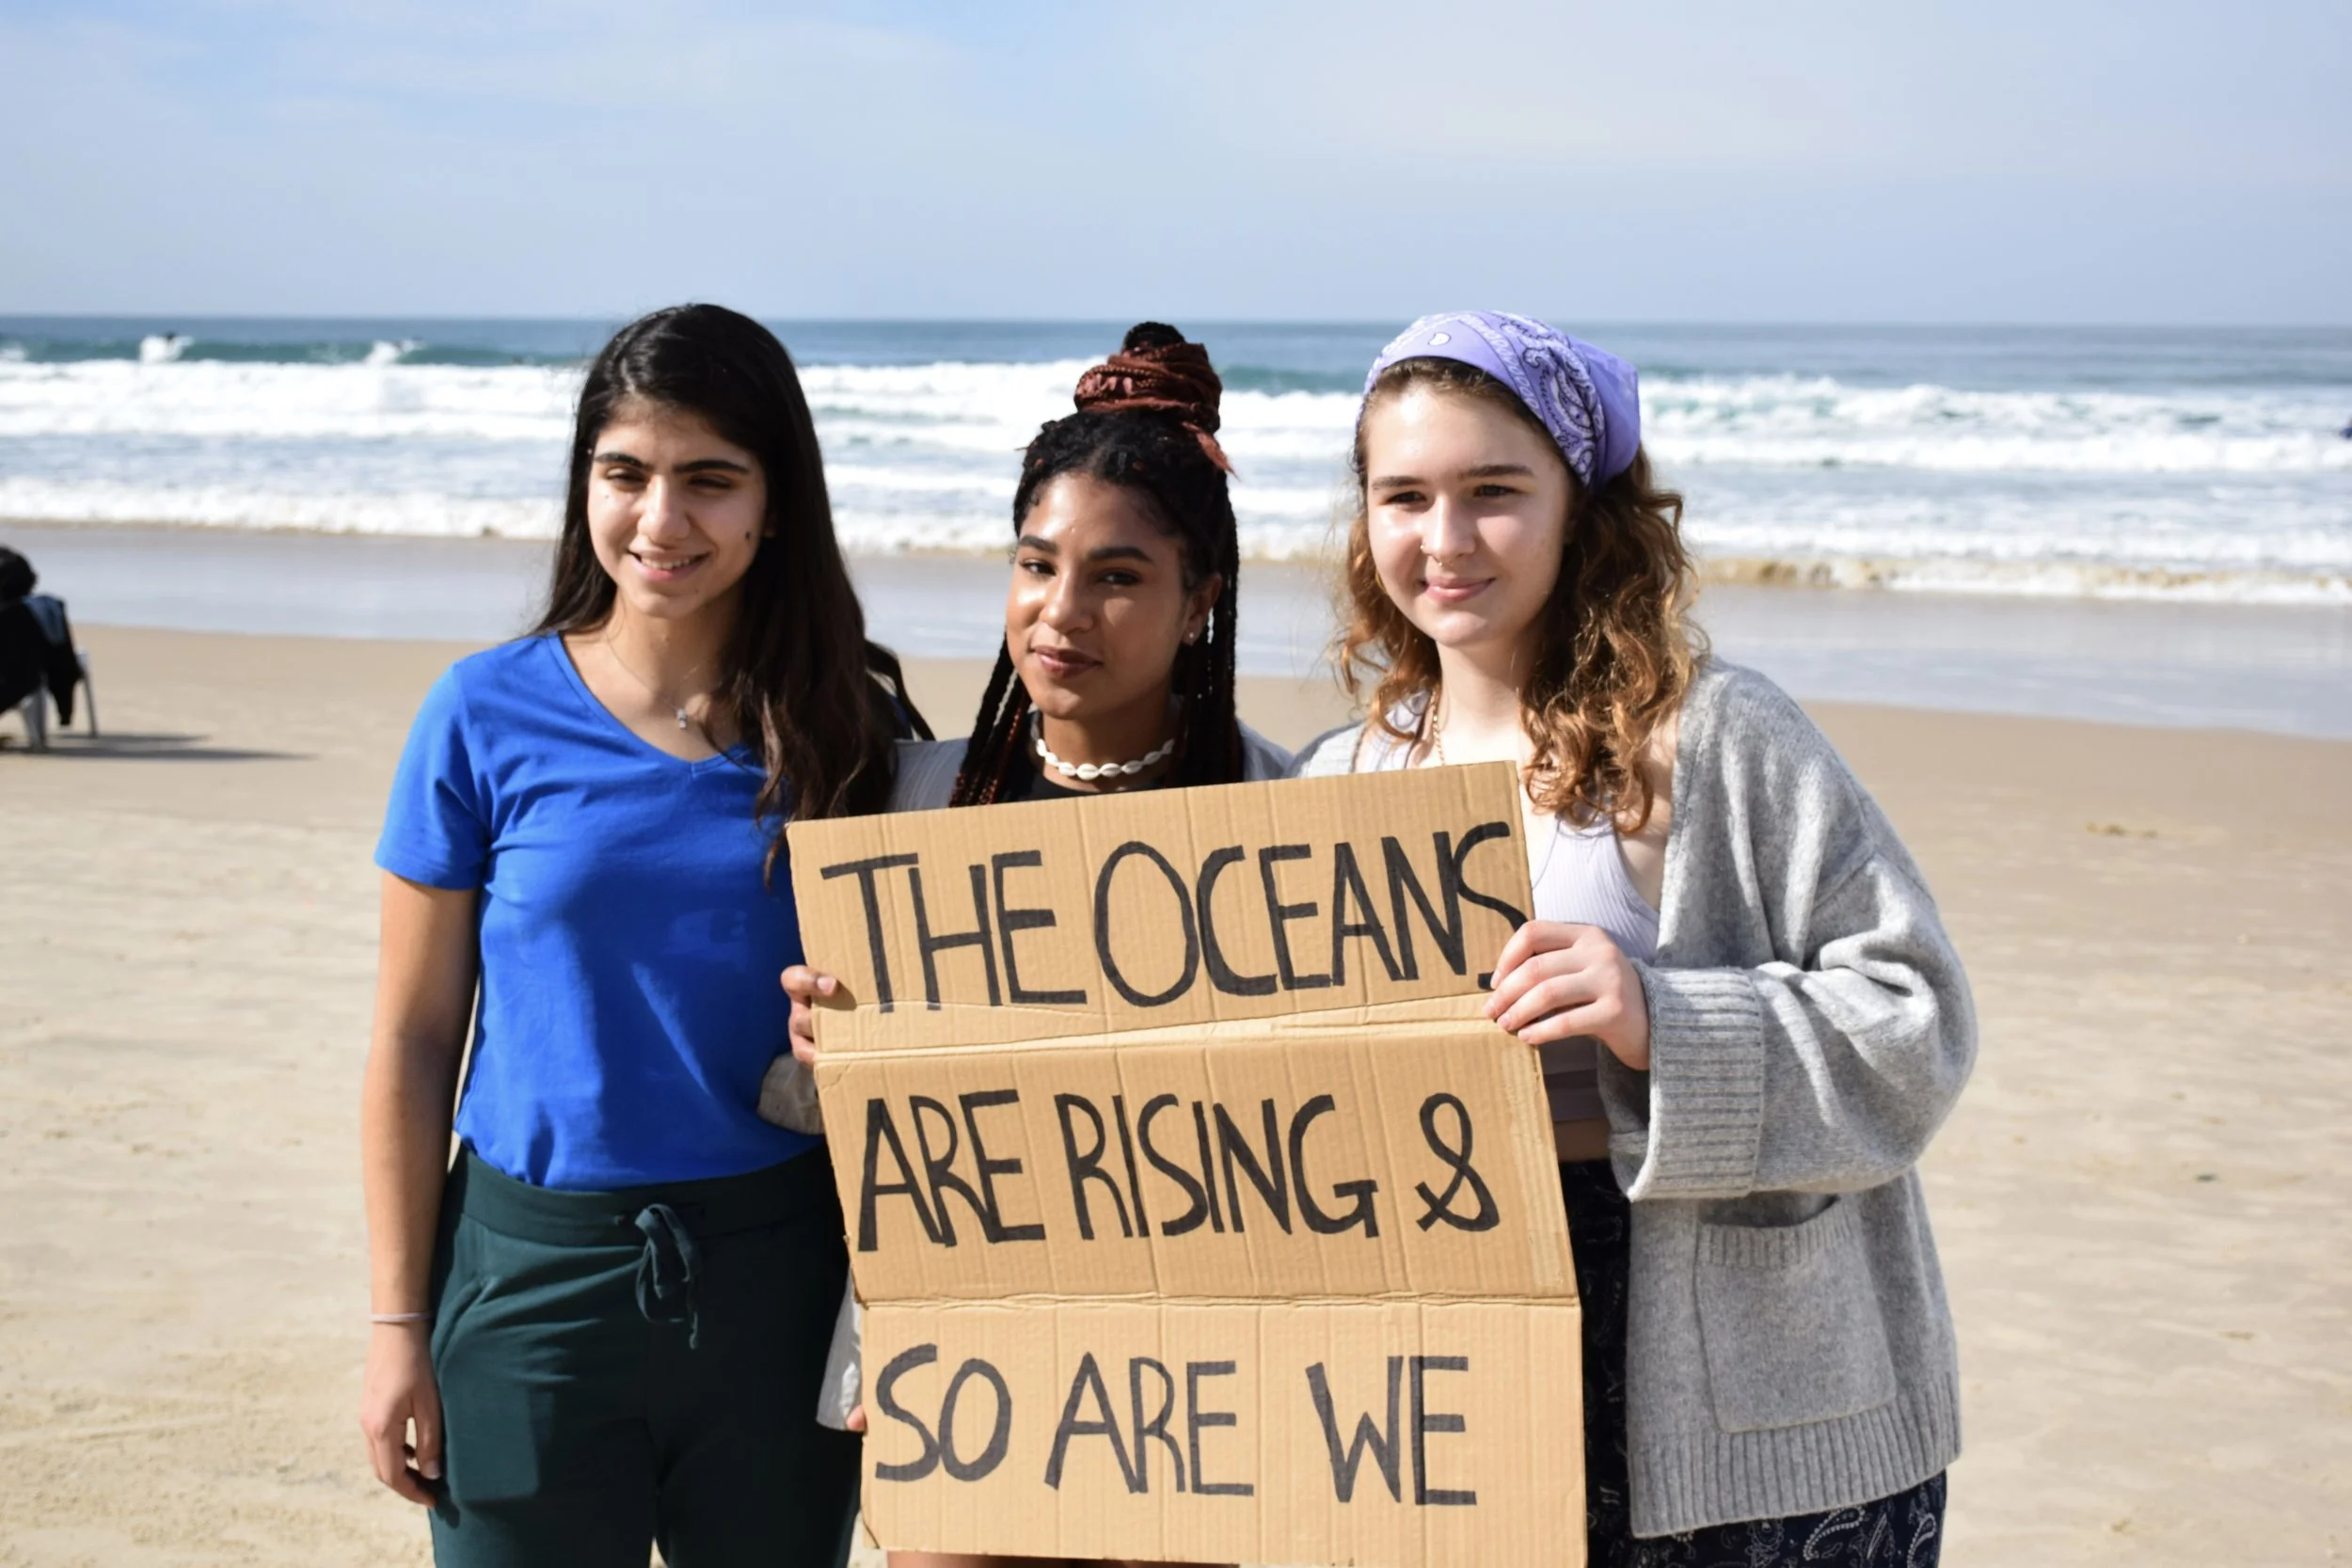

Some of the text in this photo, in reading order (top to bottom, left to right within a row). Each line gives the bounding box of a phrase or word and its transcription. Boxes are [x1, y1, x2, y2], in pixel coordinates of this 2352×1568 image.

[819, 821, 1530, 1013] THE OCEANS
[857, 1088, 1500, 1252] ARE RISING &
[875, 1343, 1477, 1506] SO ARE WE
